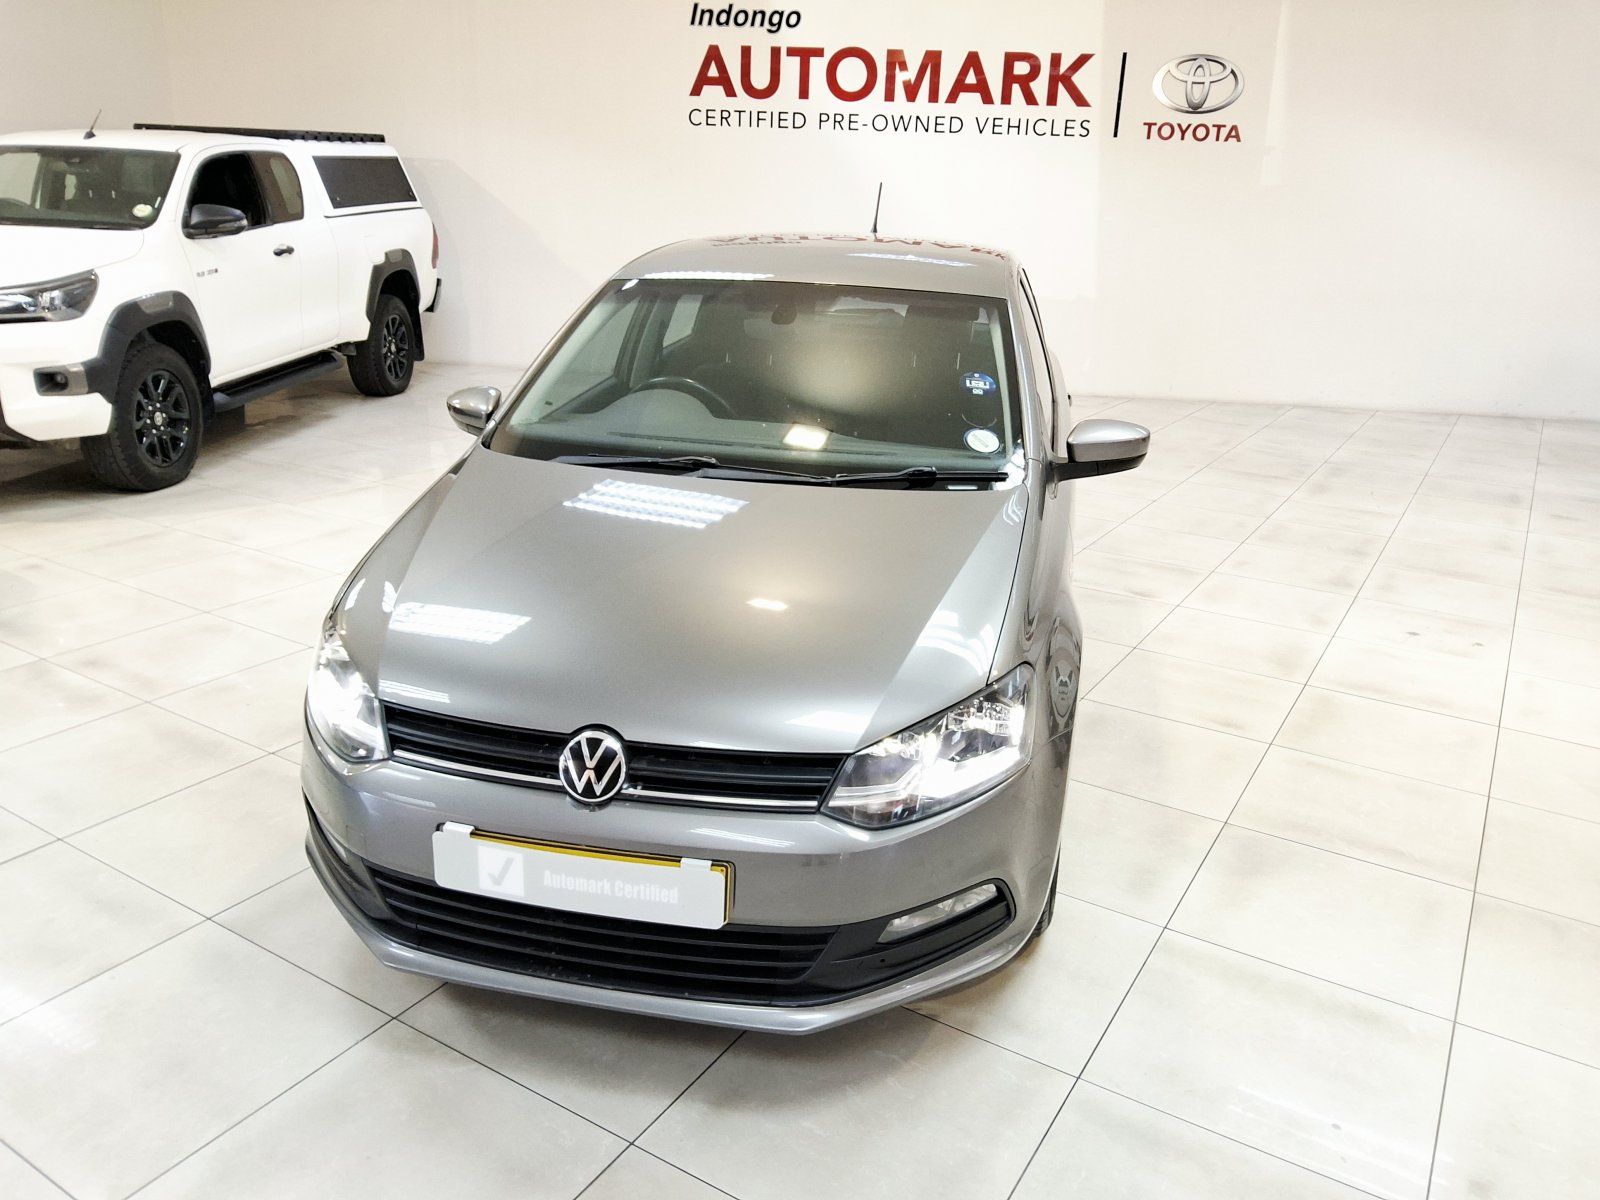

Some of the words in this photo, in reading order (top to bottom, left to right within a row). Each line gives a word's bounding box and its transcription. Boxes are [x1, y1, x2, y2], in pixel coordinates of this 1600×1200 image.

[690, 2, 801, 34] Indongo
[689, 44, 1095, 108] AUTOMARK
[688, 108, 807, 129] CERTIFIED
[818, 113, 964, 134] PRE-OWNED
[975, 117, 1091, 138] VEHICLES
[1142, 121, 1242, 143] TOYOTA
[543, 869, 611, 896] Automark
[614, 879, 679, 904] Certified
